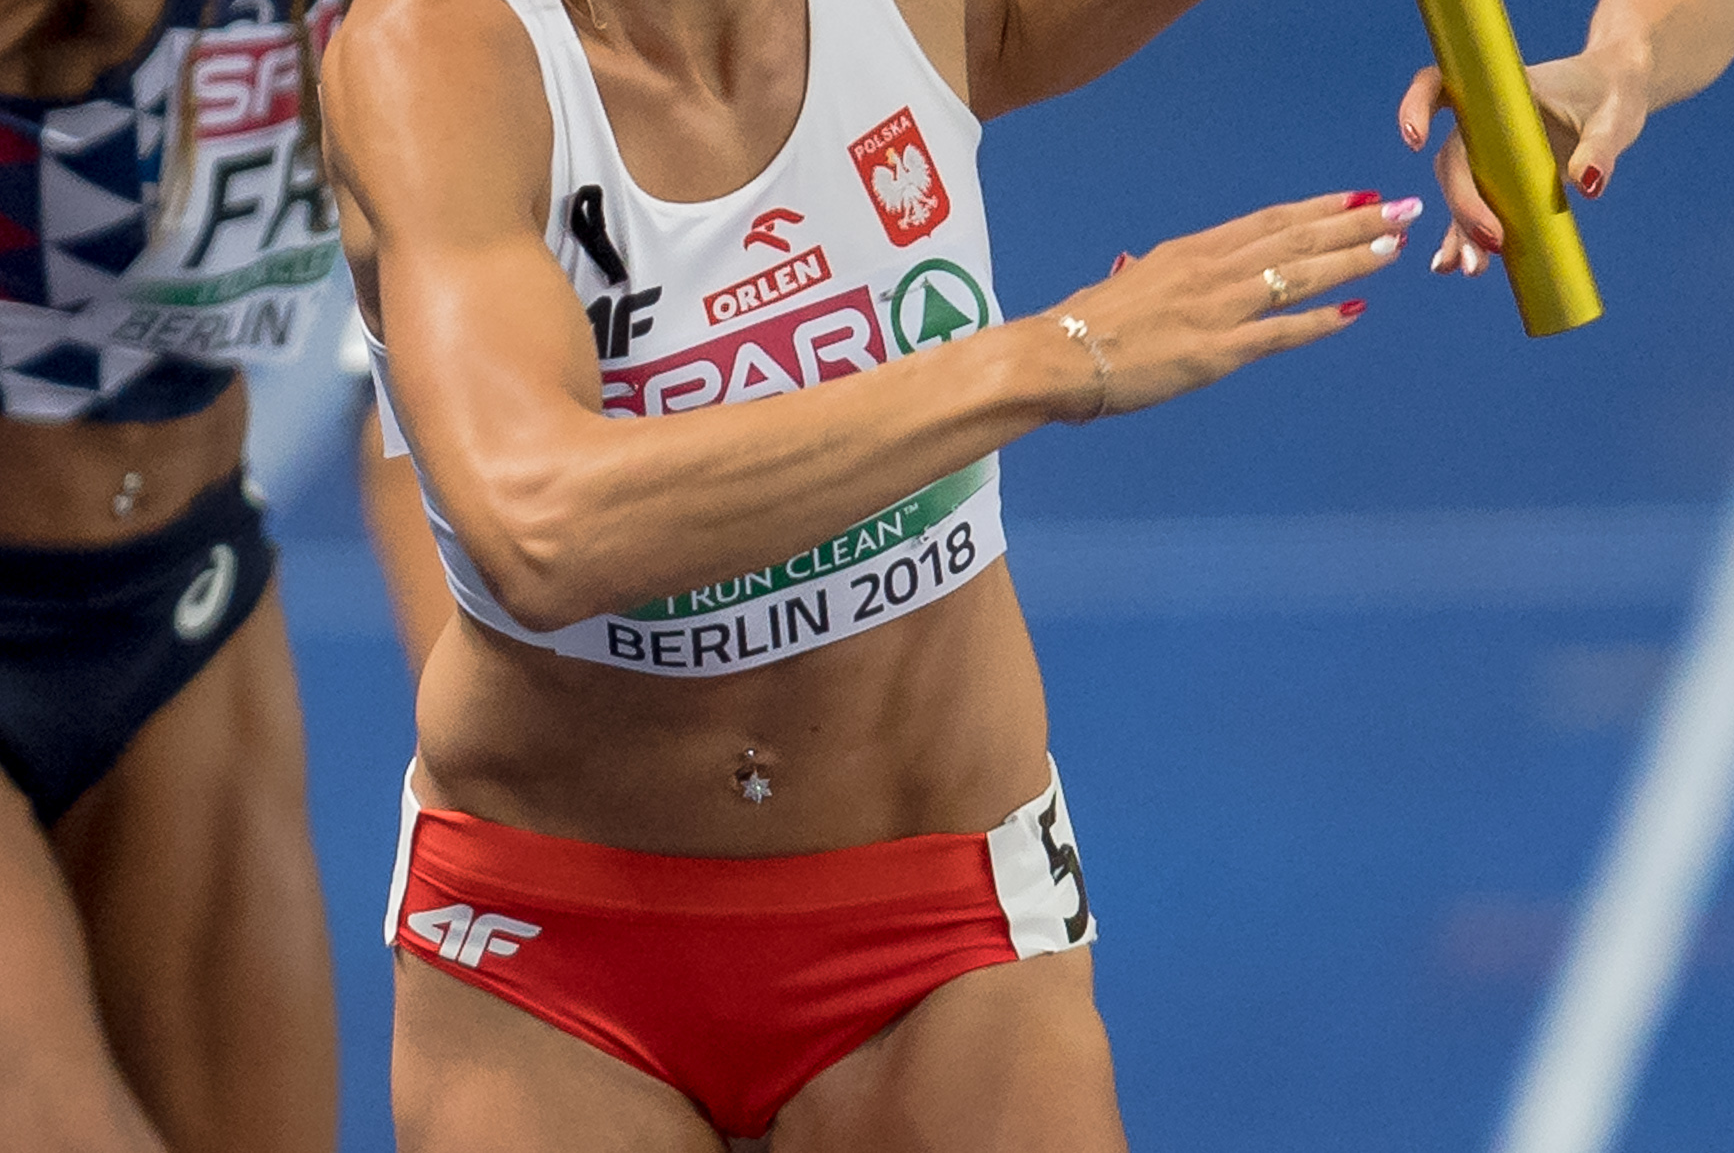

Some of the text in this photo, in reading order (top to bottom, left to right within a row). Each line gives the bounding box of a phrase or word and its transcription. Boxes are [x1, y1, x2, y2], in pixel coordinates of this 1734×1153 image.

[853, 114, 912, 160] POLSKA
[709, 256, 822, 323] ORLEN
[606, 521, 976, 668] BERLIN 2018
[690, 566, 772, 612] RUN
[406, 903, 542, 968] 4F
